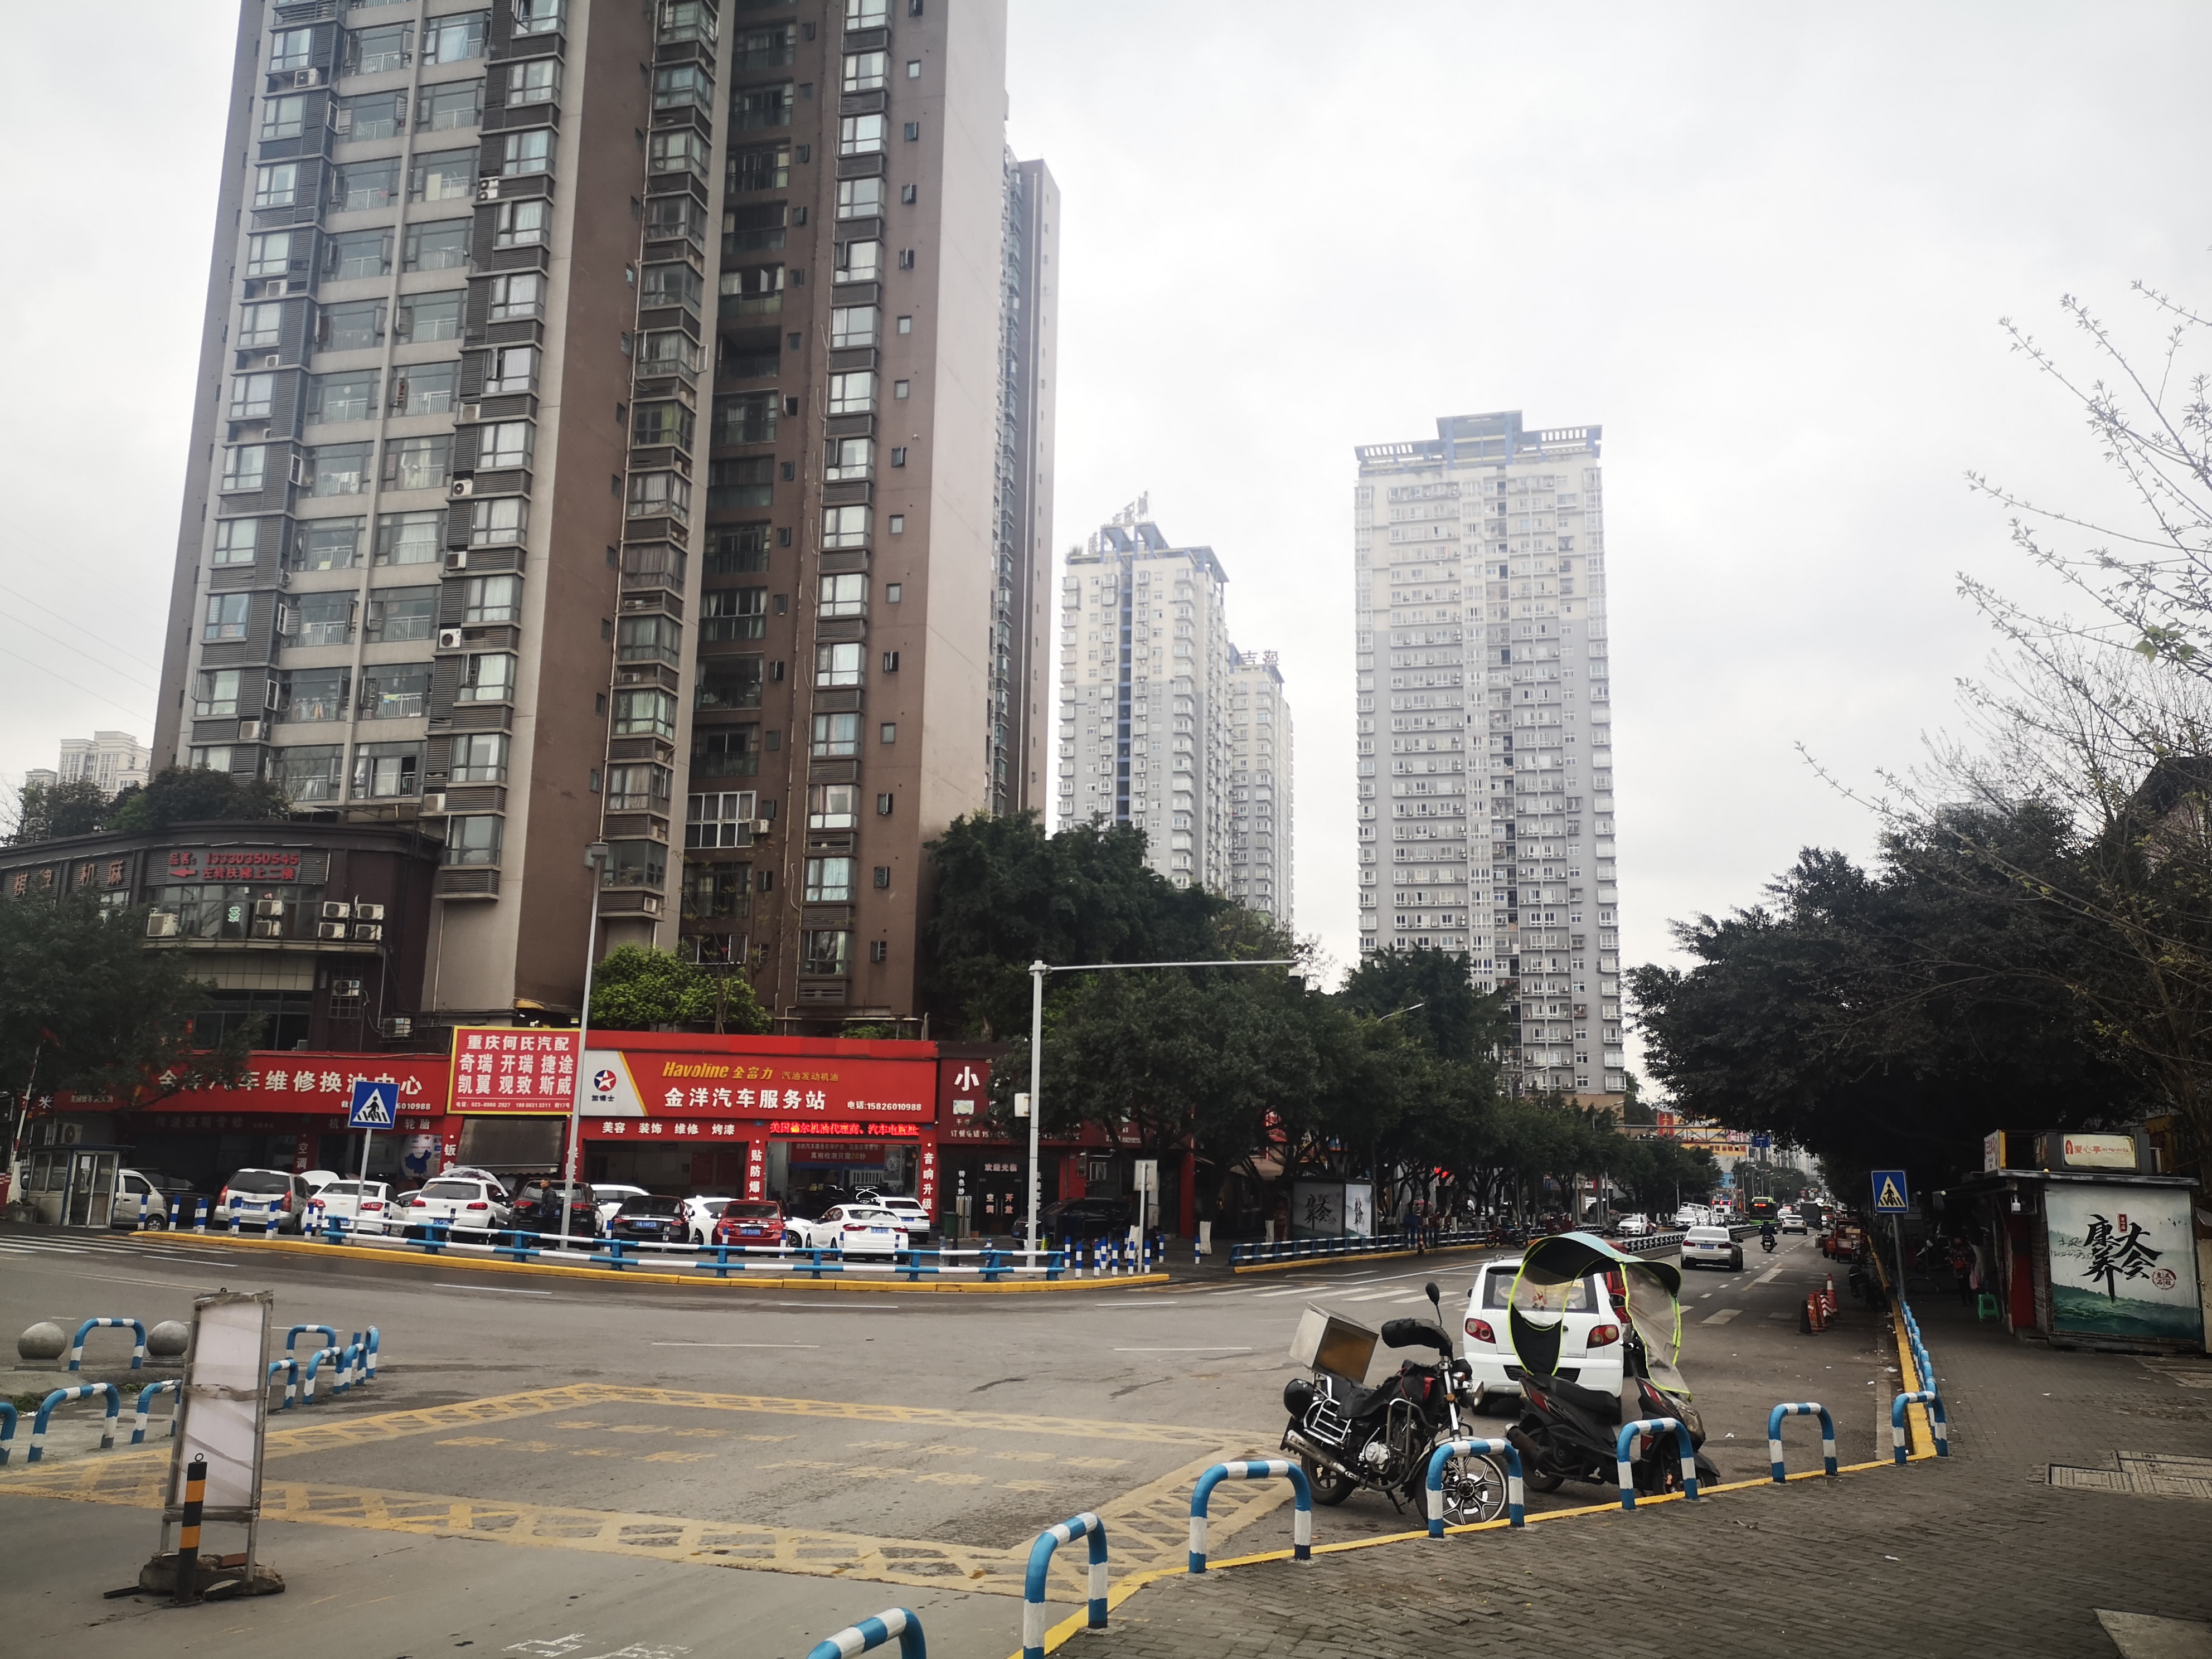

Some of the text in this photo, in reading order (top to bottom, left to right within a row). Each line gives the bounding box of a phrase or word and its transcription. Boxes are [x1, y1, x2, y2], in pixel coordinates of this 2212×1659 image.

[206, 853, 298, 864] 13330350545
[228, 905, 241, 922] 茶
[467, 1035, 569, 1051] 重庆何氏汽配
[459, 1052, 574, 1074] 奇瑞 开瑞 捷途
[662, 1061, 730, 1079] Havoline
[731, 1066, 838, 1081] 金富力 汽油发动机油
[954, 1066, 979, 1092] 小
[458, 1074, 572, 1095] 凯翼 观致 斯威
[664, 1087, 826, 1110] 金洋汽车服务站
[847, 1100, 921, 1111] 电话:15826010988
[405, 1118, 430, 1130] 轮胎
[602, 1122, 735, 1136] 美容 装饰 维修 烤漆
[297, 1142, 308, 1169] 空调
[2074, 1145, 2101, 1154] 爱心亭
[922, 1152, 934, 1209] 音响升级
